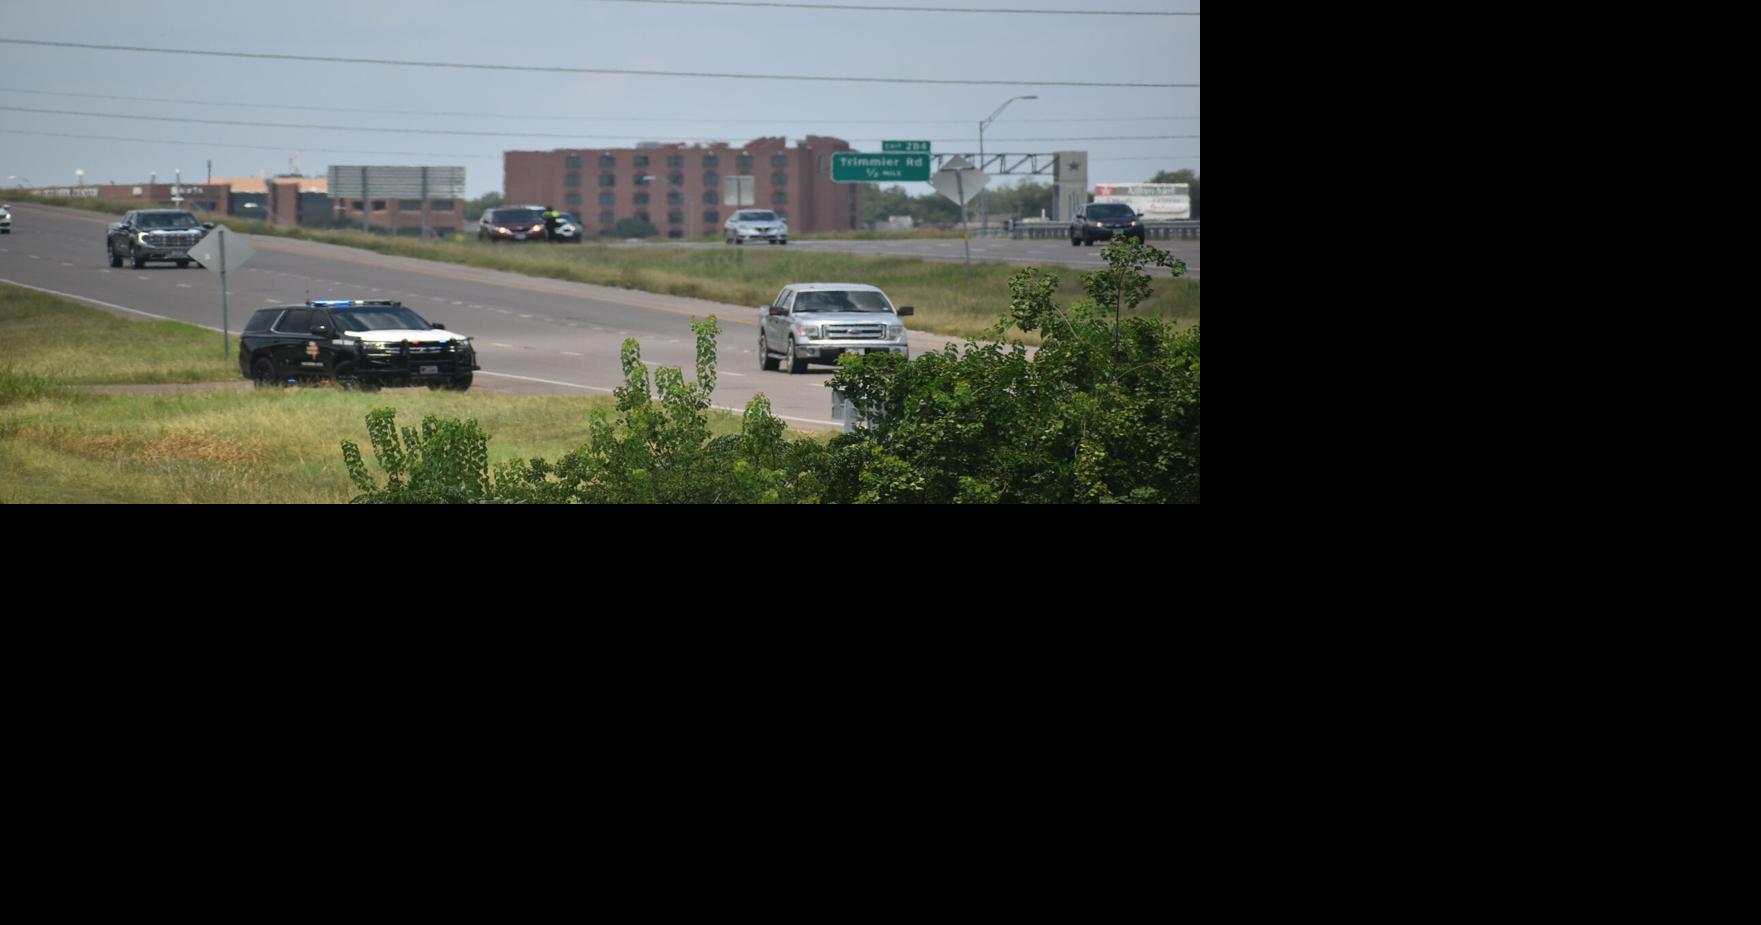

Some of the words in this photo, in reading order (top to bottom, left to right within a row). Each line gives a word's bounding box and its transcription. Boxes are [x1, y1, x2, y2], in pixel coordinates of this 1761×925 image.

[905, 142, 928, 151] 284
[841, 156, 899, 167] Trimmier
[906, 156, 924, 167] Rd
[882, 169, 902, 177] MILE
